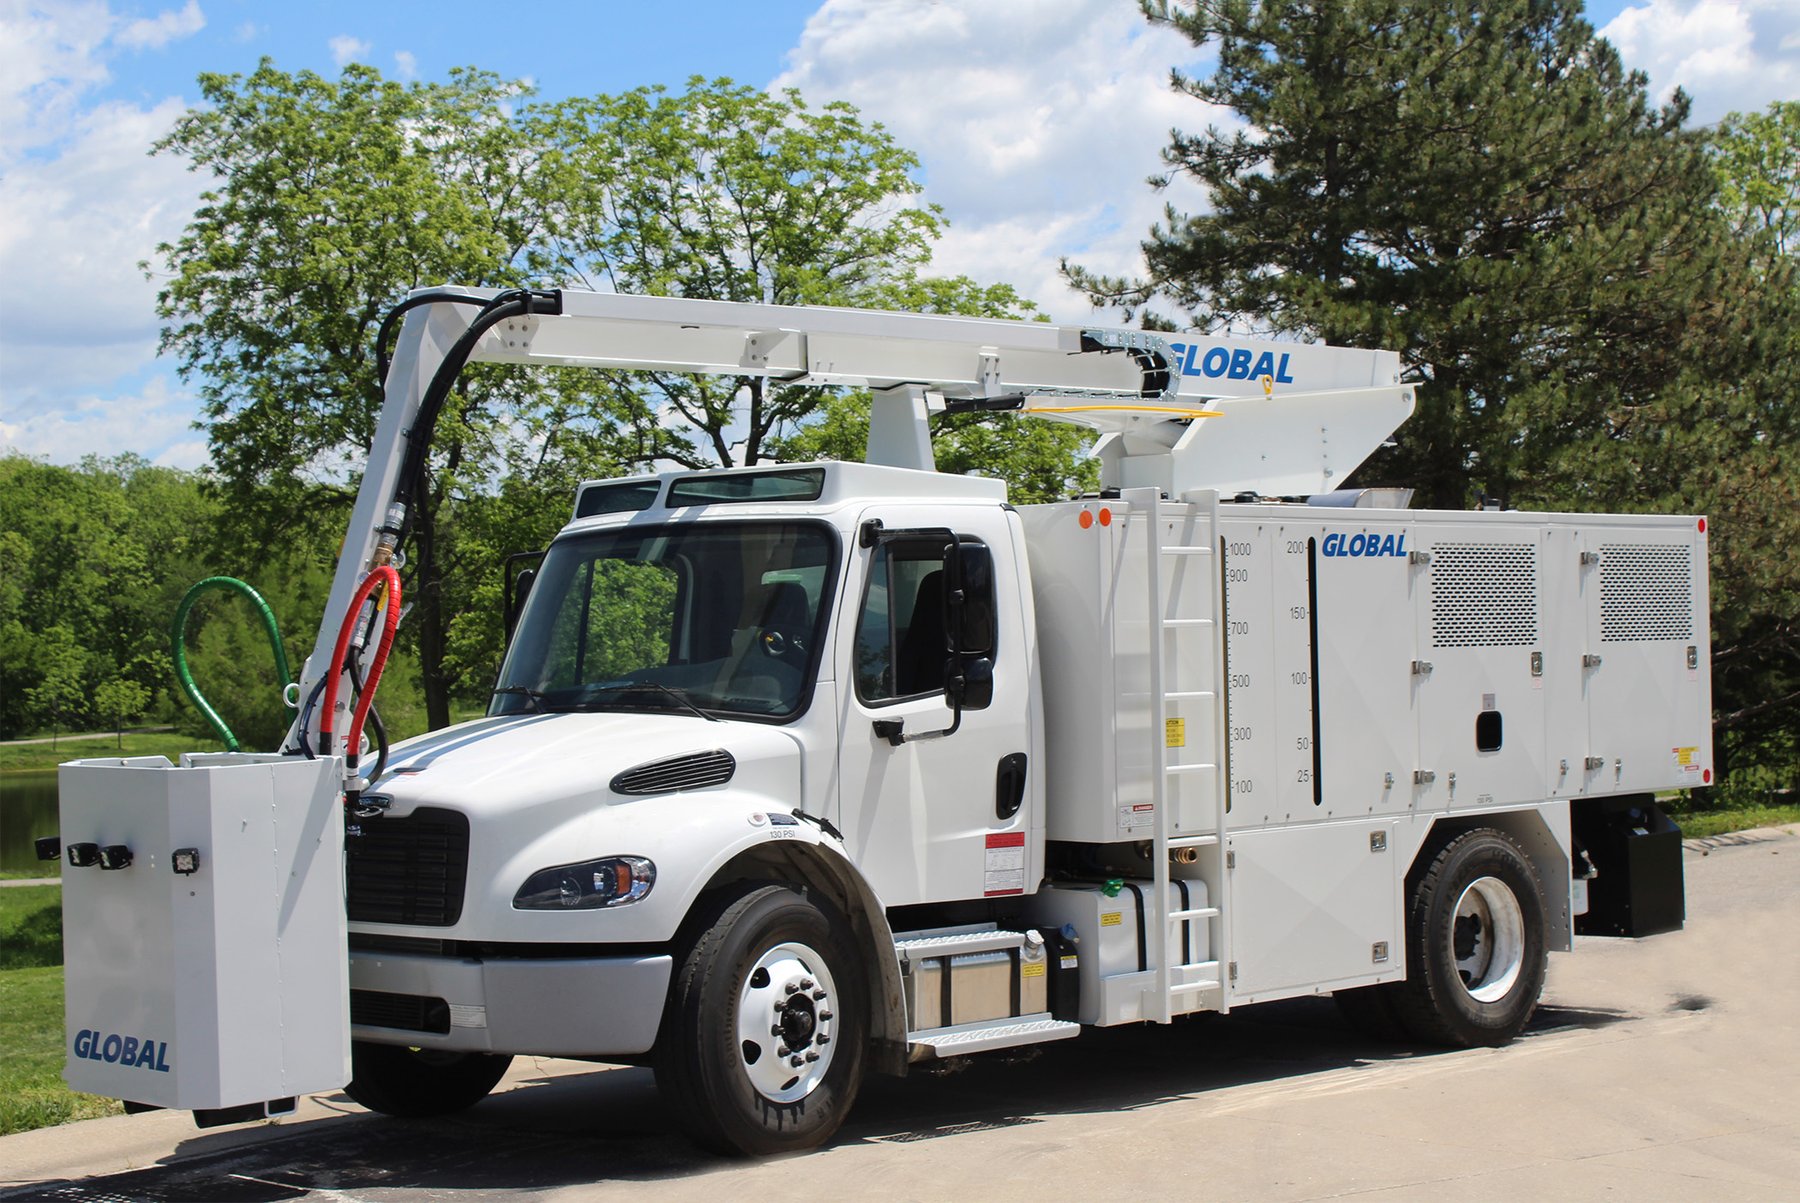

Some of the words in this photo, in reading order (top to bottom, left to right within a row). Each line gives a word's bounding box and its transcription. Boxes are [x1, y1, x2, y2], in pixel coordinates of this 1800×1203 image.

[1230, 542, 1251, 556] 1000
[1287, 541, 1304, 554] 200
[1322, 533, 1407, 557] GLOBAL
[1230, 569, 1248, 582] 900
[1290, 607, 1305, 620] 150
[1232, 622, 1249, 635] 700
[1232, 674, 1250, 688] 500
[1291, 672, 1307, 685] 100
[1233, 727, 1251, 740] 300
[1297, 737, 1309, 750] 50
[1297, 769, 1309, 783] 25
[1235, 780, 1253, 793] 100
[770, 830, 782, 838] 130
[783, 830, 796, 838] PSI
[74, 1029, 170, 1072] GLOBAL
